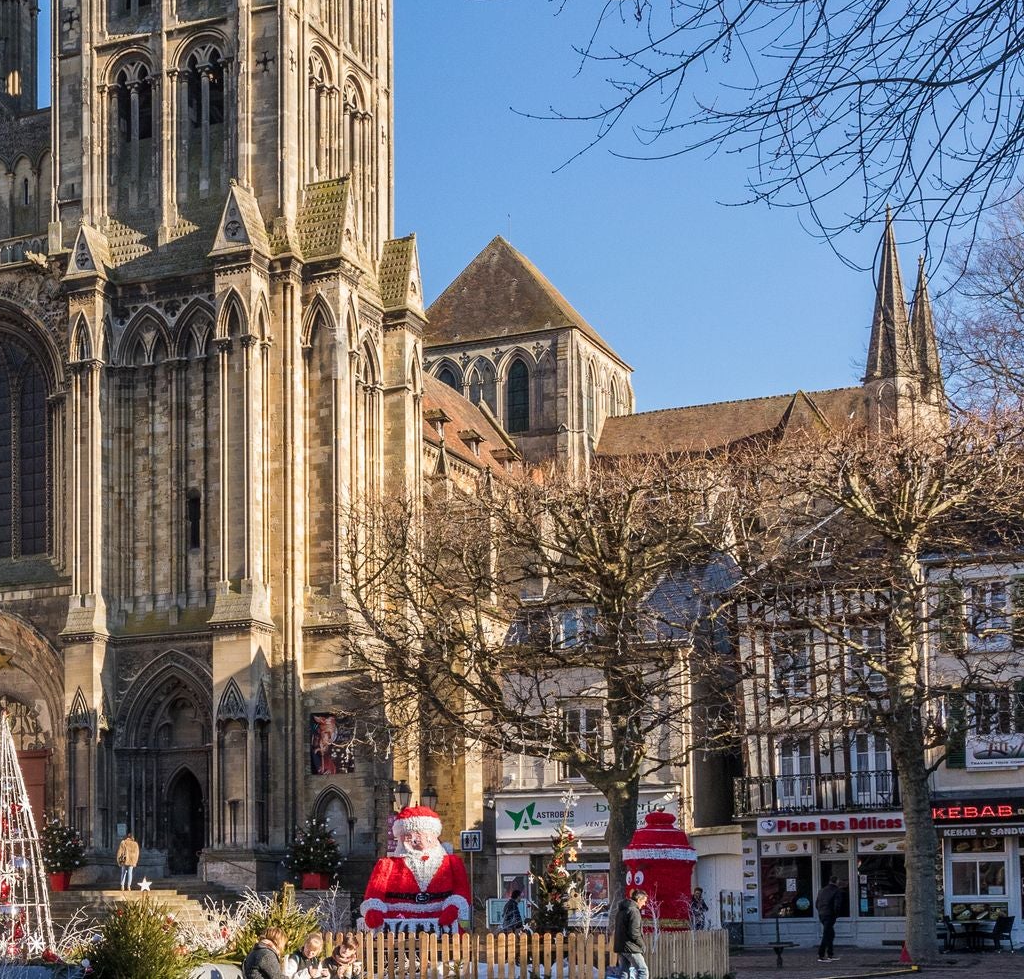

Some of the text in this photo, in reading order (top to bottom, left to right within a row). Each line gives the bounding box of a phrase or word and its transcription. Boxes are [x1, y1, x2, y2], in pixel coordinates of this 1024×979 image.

[536, 810, 575, 819] ASTROBUS
[932, 805, 1013, 819] KEBAB
[777, 817, 903, 832] Place Des Délices
[943, 828, 977, 836] KEBAB
